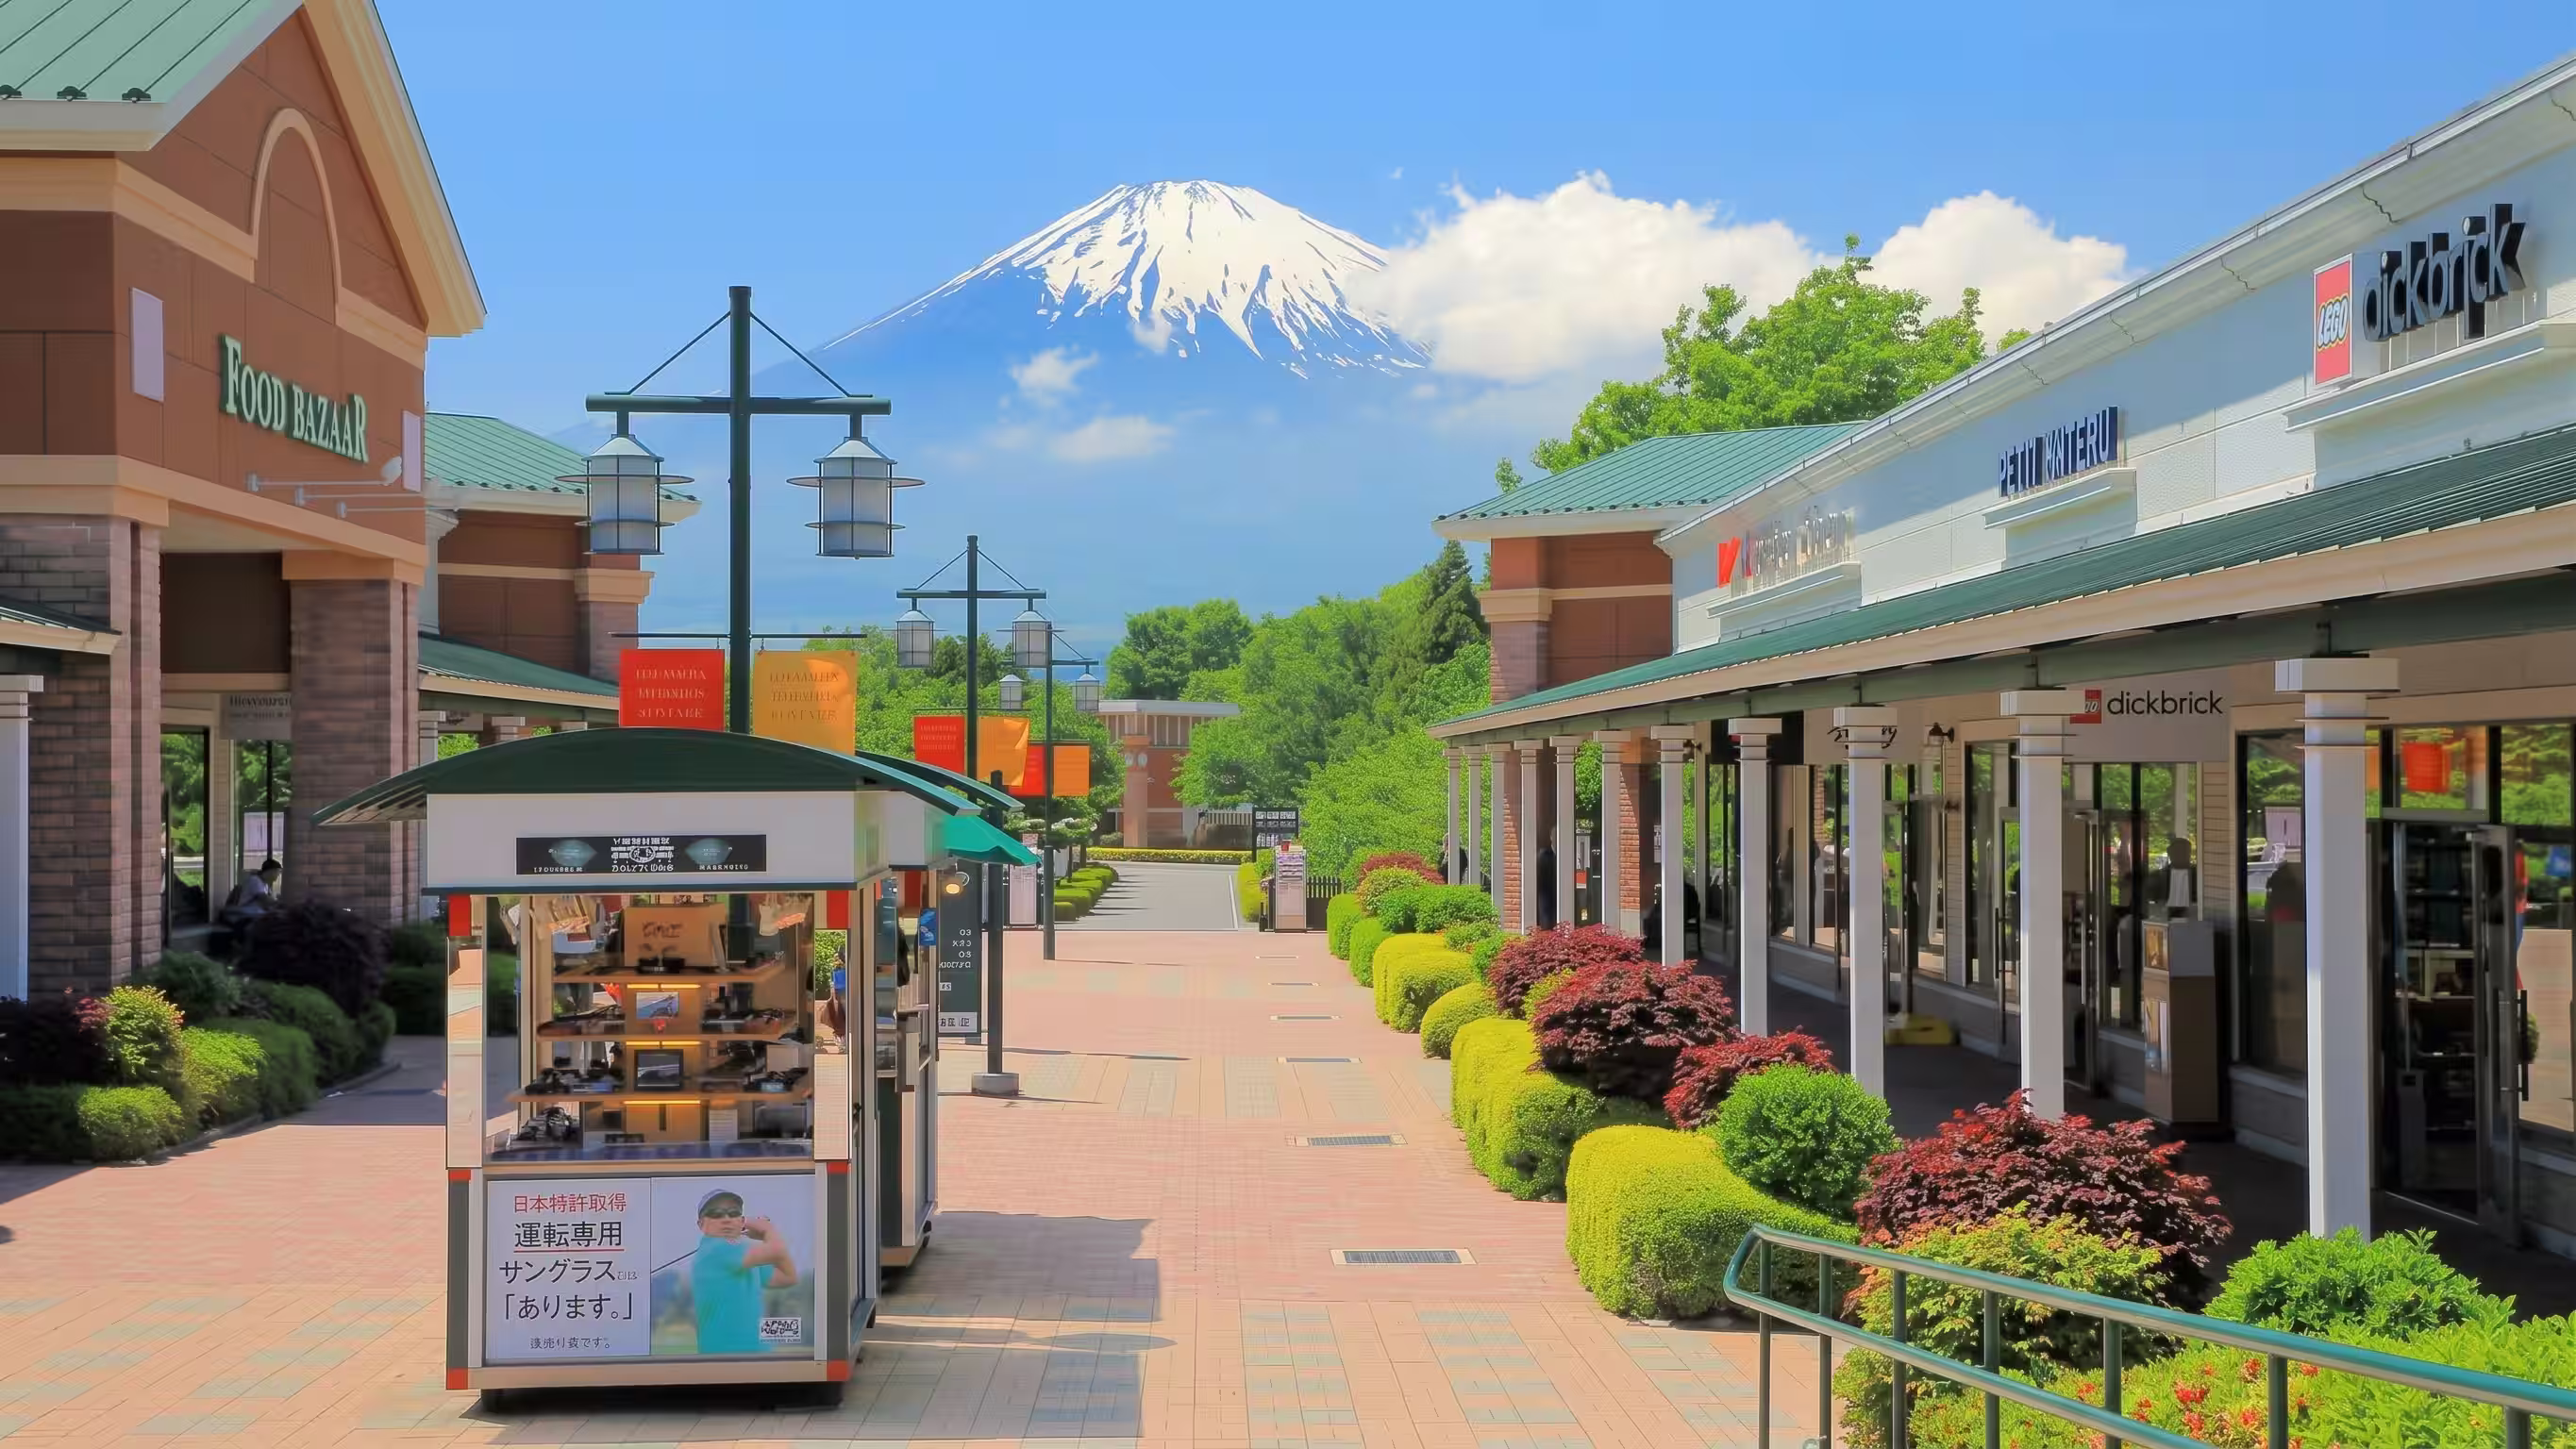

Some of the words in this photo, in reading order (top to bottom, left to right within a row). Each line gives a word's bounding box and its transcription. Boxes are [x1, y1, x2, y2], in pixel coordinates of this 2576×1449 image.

[2317, 293, 2350, 352] LEGO
[223, 333, 285, 432] FOOD
[288, 383, 369, 463] BAZAAR
[513, 1192, 627, 1214] 日本特許取得
[514, 1221, 623, 1248] 運転専用
[498, 1257, 616, 1284] サングラス
[505, 1292, 633, 1321] 「あります。」
